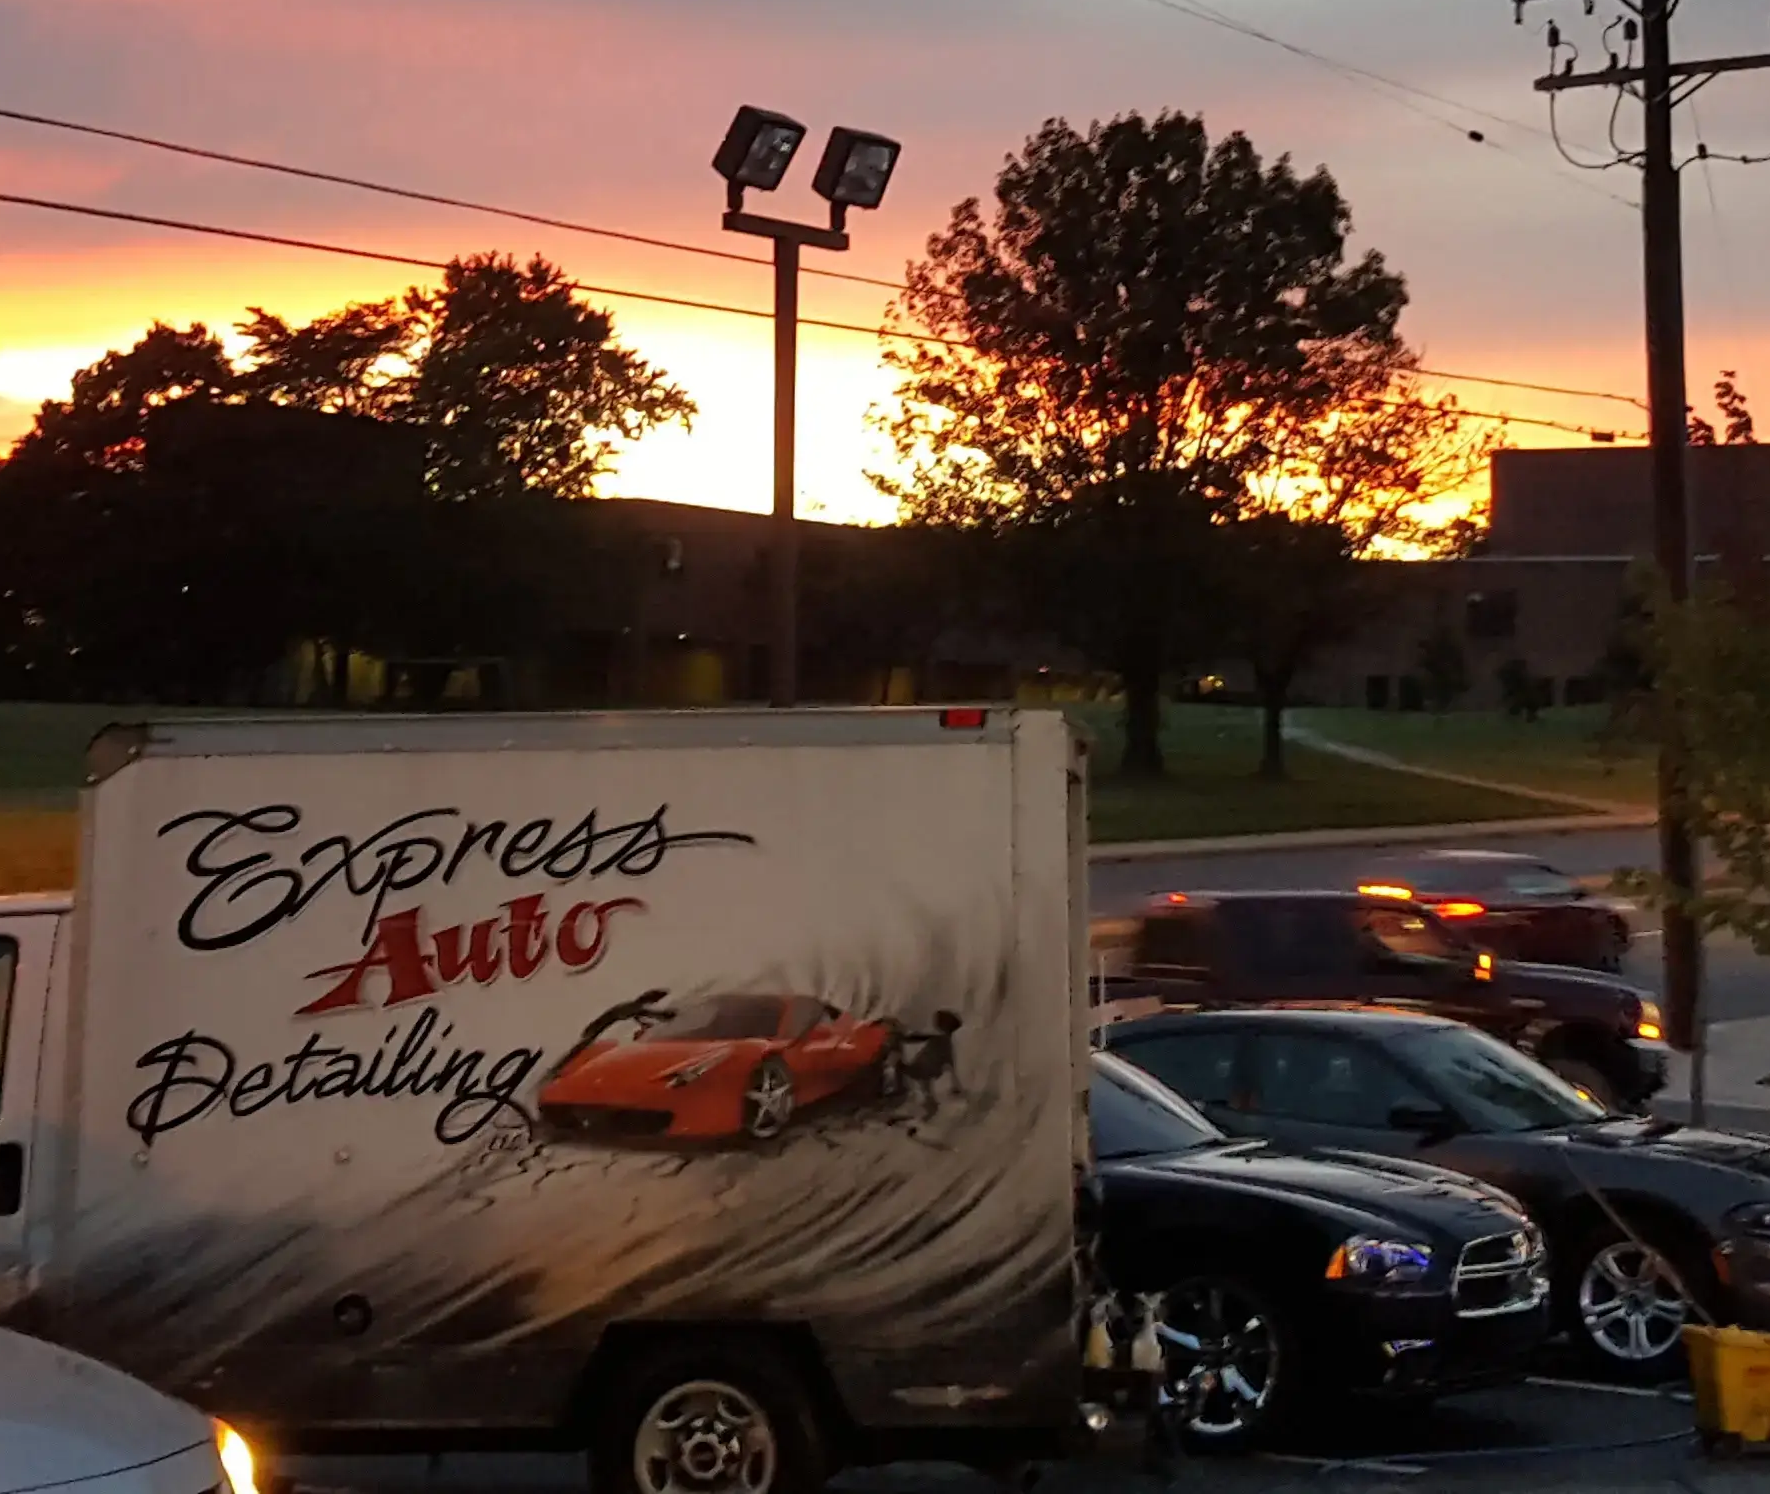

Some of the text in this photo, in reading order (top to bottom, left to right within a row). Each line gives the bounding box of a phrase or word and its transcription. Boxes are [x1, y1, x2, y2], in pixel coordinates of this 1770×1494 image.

[157, 801, 756, 951] Express
[294, 891, 648, 1017] Auto
[125, 1006, 544, 1148] Detailing
